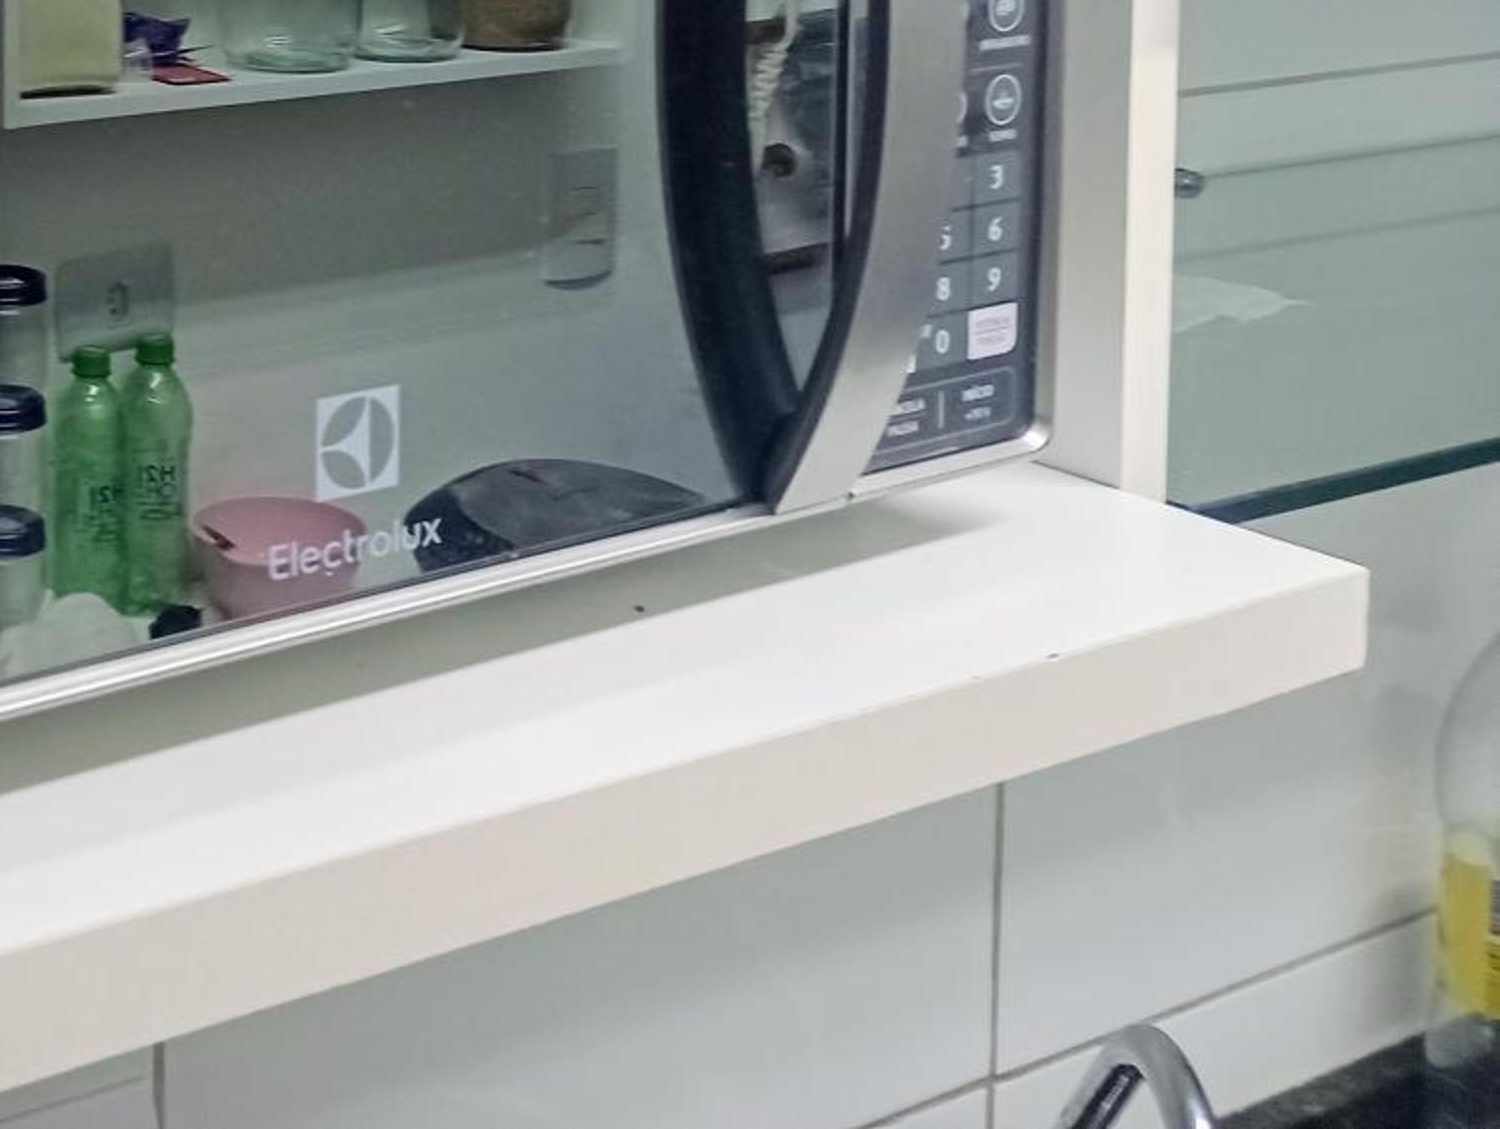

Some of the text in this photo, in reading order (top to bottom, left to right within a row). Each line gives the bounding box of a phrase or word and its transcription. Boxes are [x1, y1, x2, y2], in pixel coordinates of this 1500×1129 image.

[988, 164, 1004, 190] 3
[988, 217, 1003, 242] 6
[936, 276, 951, 301] 8
[987, 267, 1002, 292] 9
[934, 329, 950, 354] 0
[268, 518, 442, 581] Electrolux
